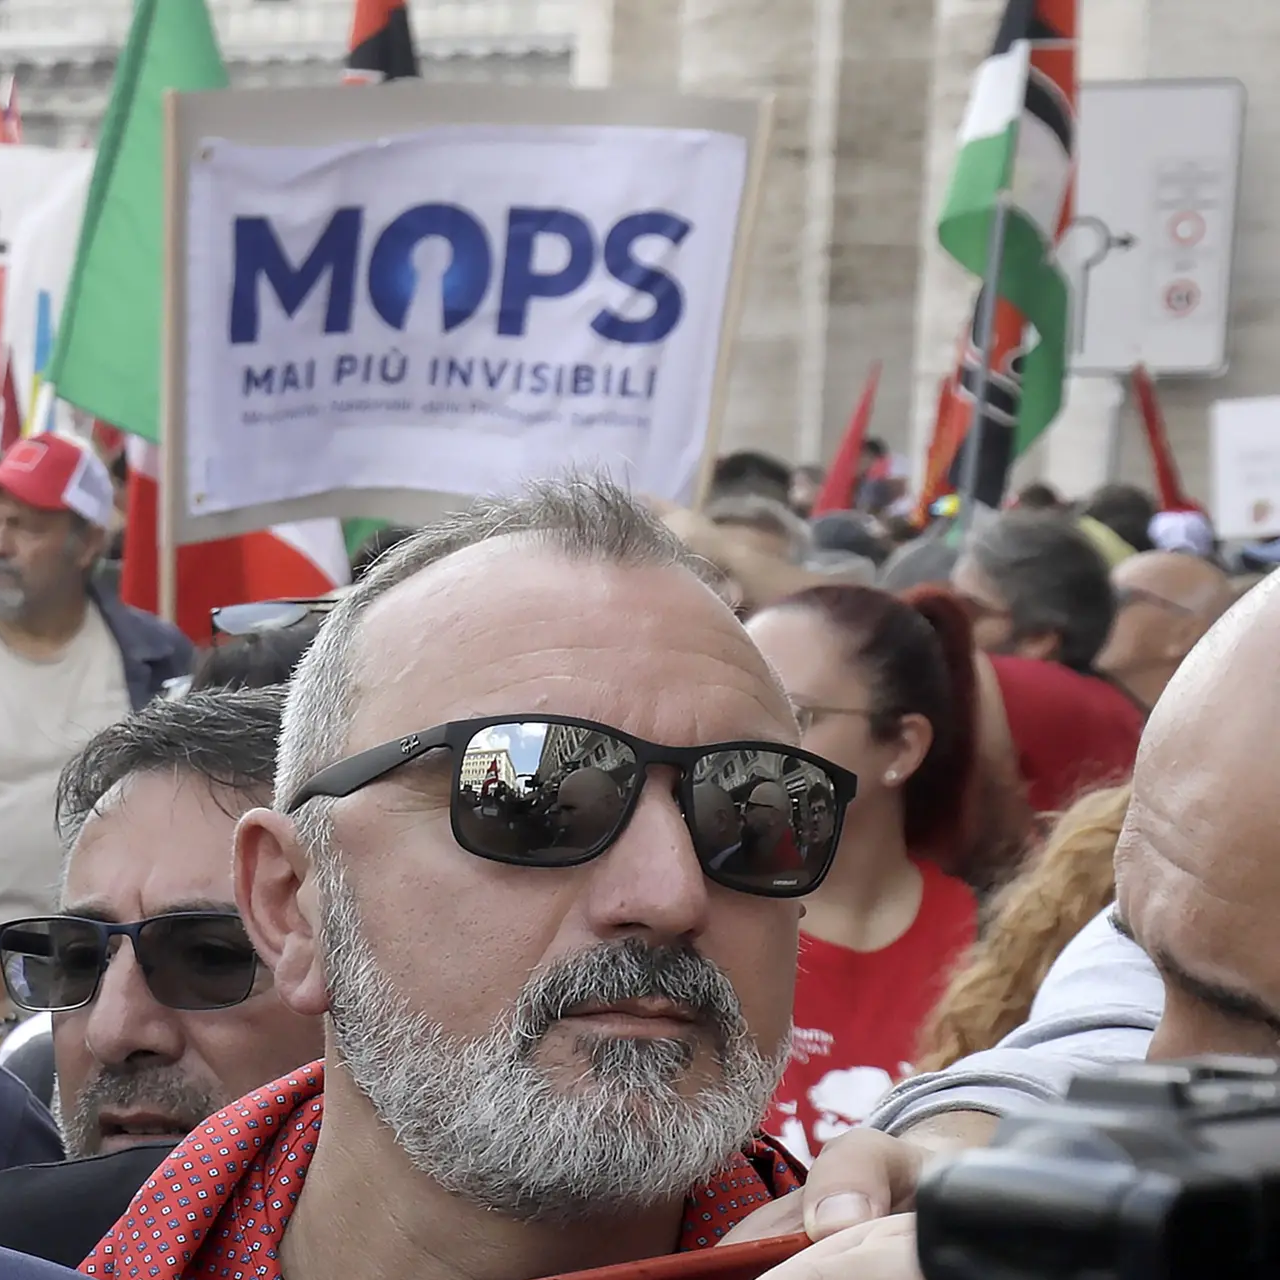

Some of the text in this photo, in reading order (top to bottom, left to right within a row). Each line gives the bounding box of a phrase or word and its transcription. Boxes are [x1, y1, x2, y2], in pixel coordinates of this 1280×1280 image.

[228, 201, 696, 344] MOPS
[242, 346, 659, 400] MAI PIÙ INVISIBILI
